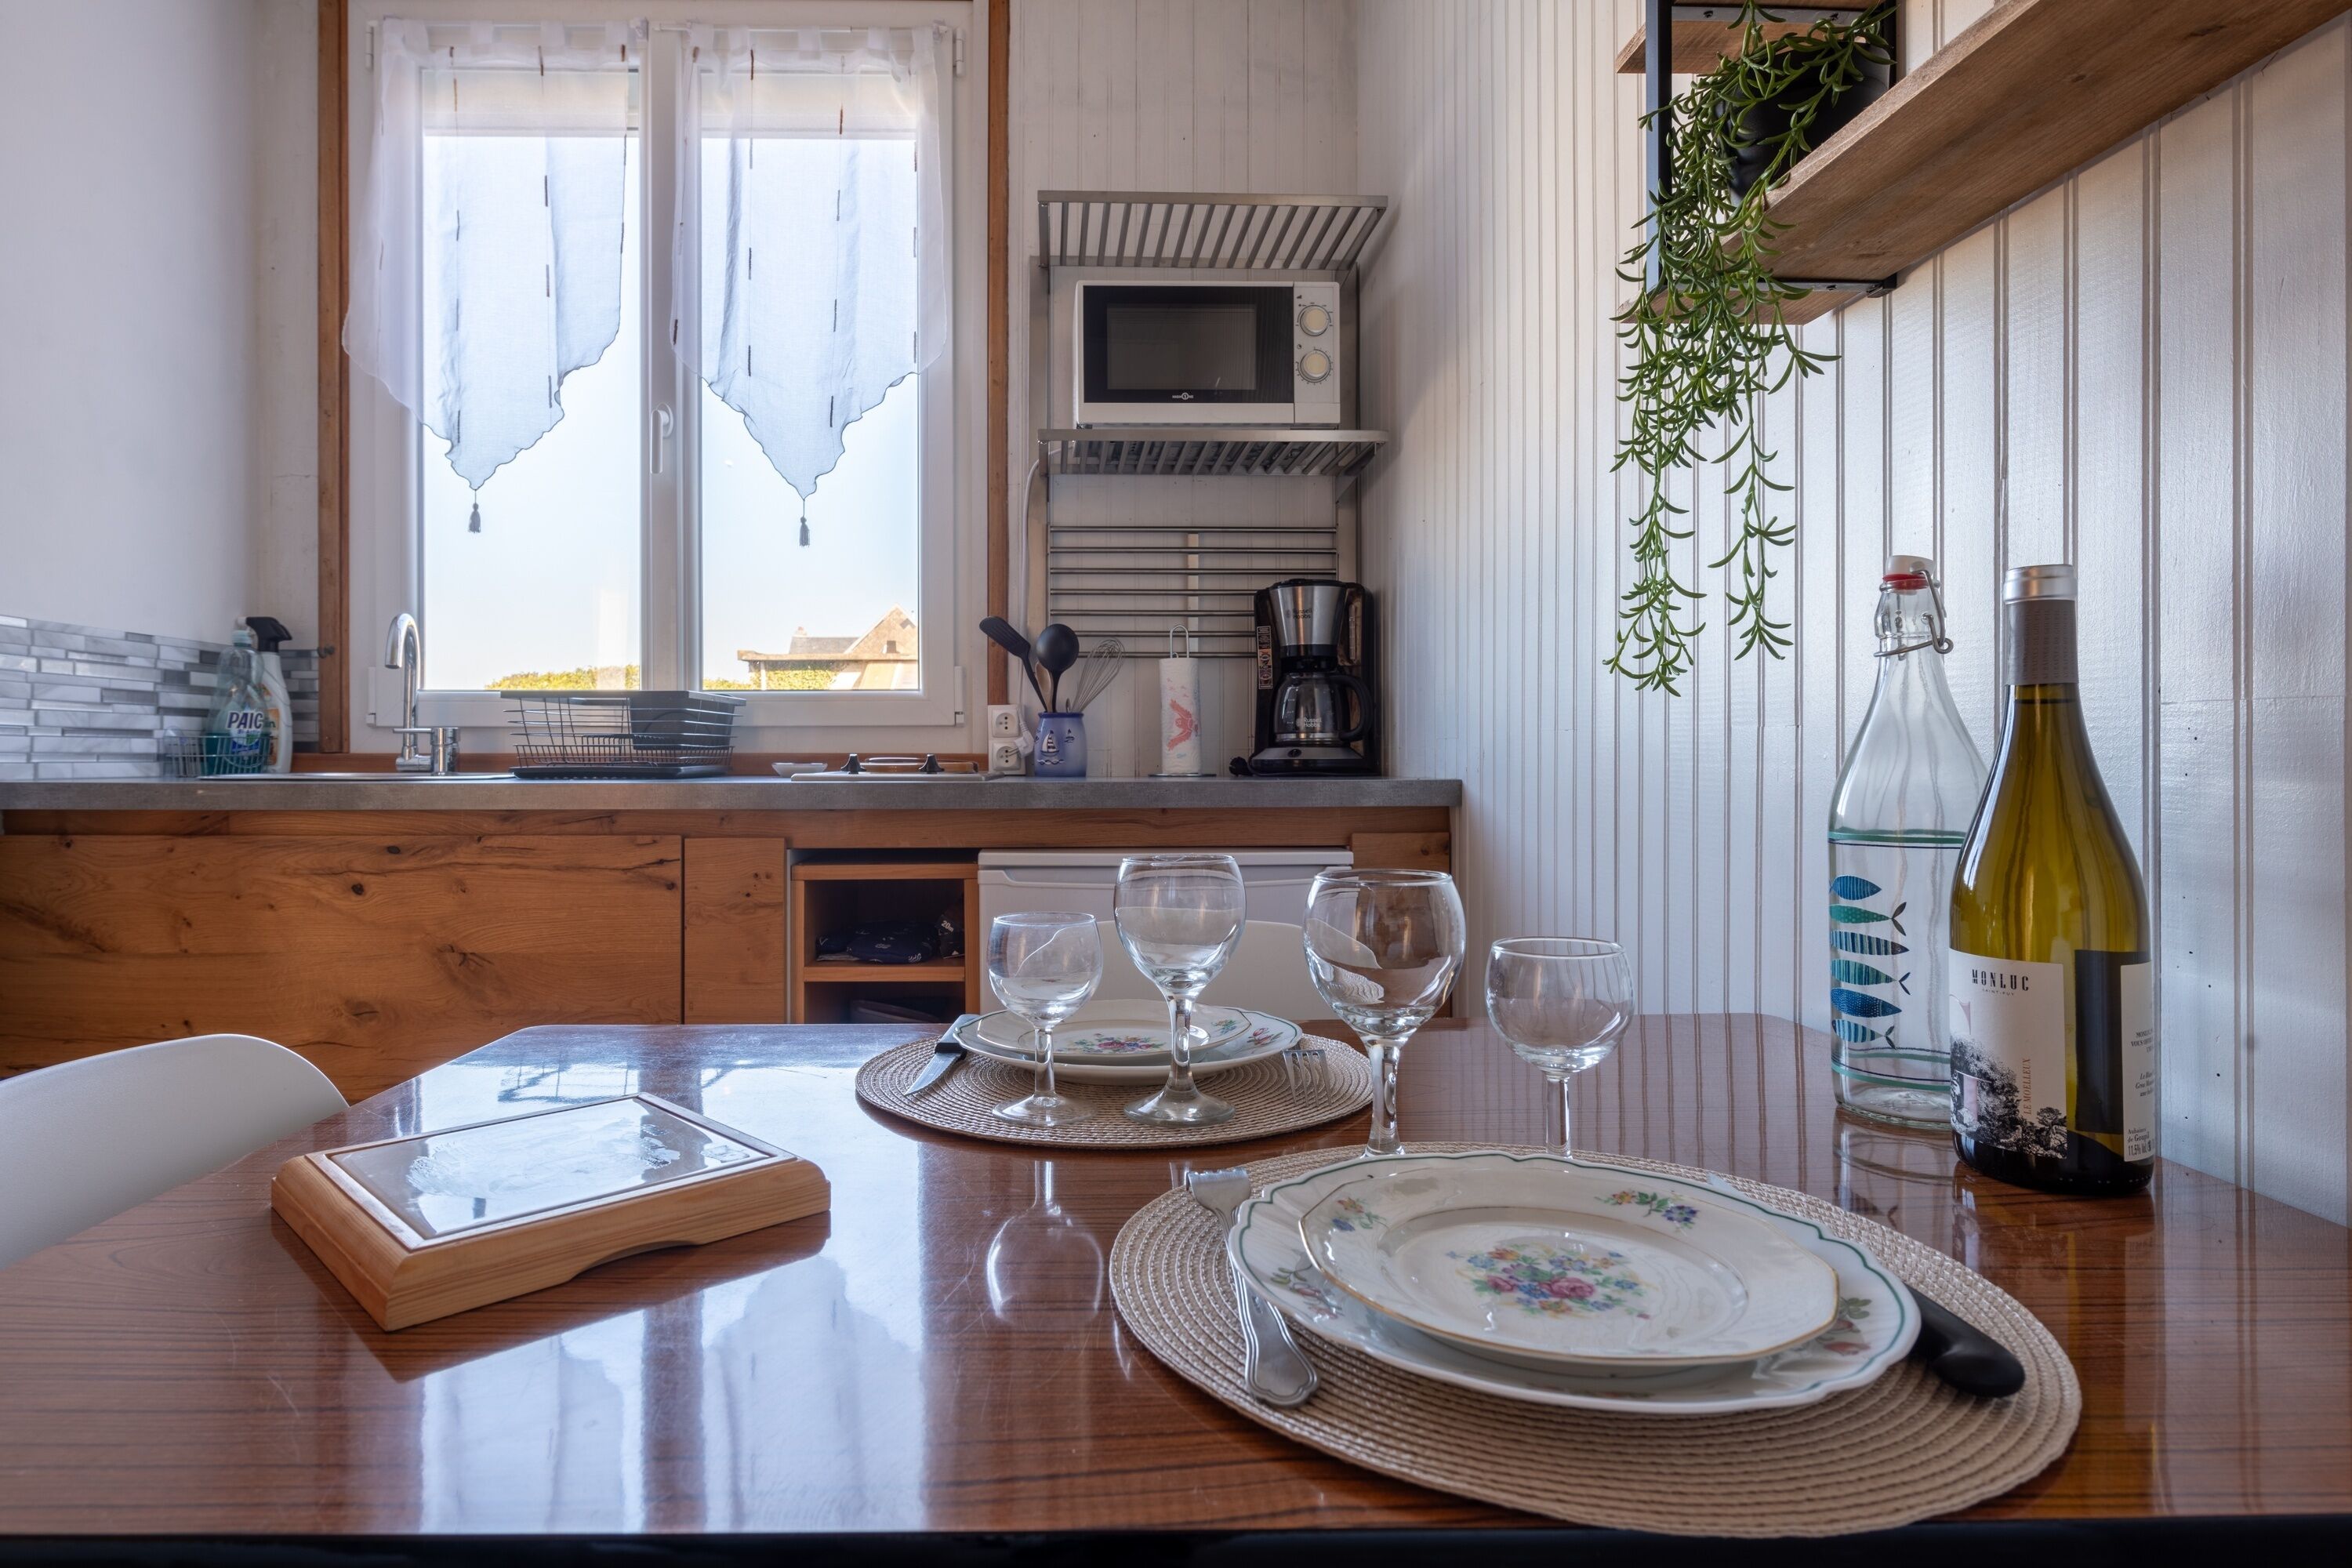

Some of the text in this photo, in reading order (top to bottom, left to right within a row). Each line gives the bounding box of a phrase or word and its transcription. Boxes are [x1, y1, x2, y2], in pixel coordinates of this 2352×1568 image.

[227, 712, 263, 729] PAIC
[1972, 968, 2029, 992] MONLUC
[2022, 1058, 2032, 1115] LE MOELLEUX
